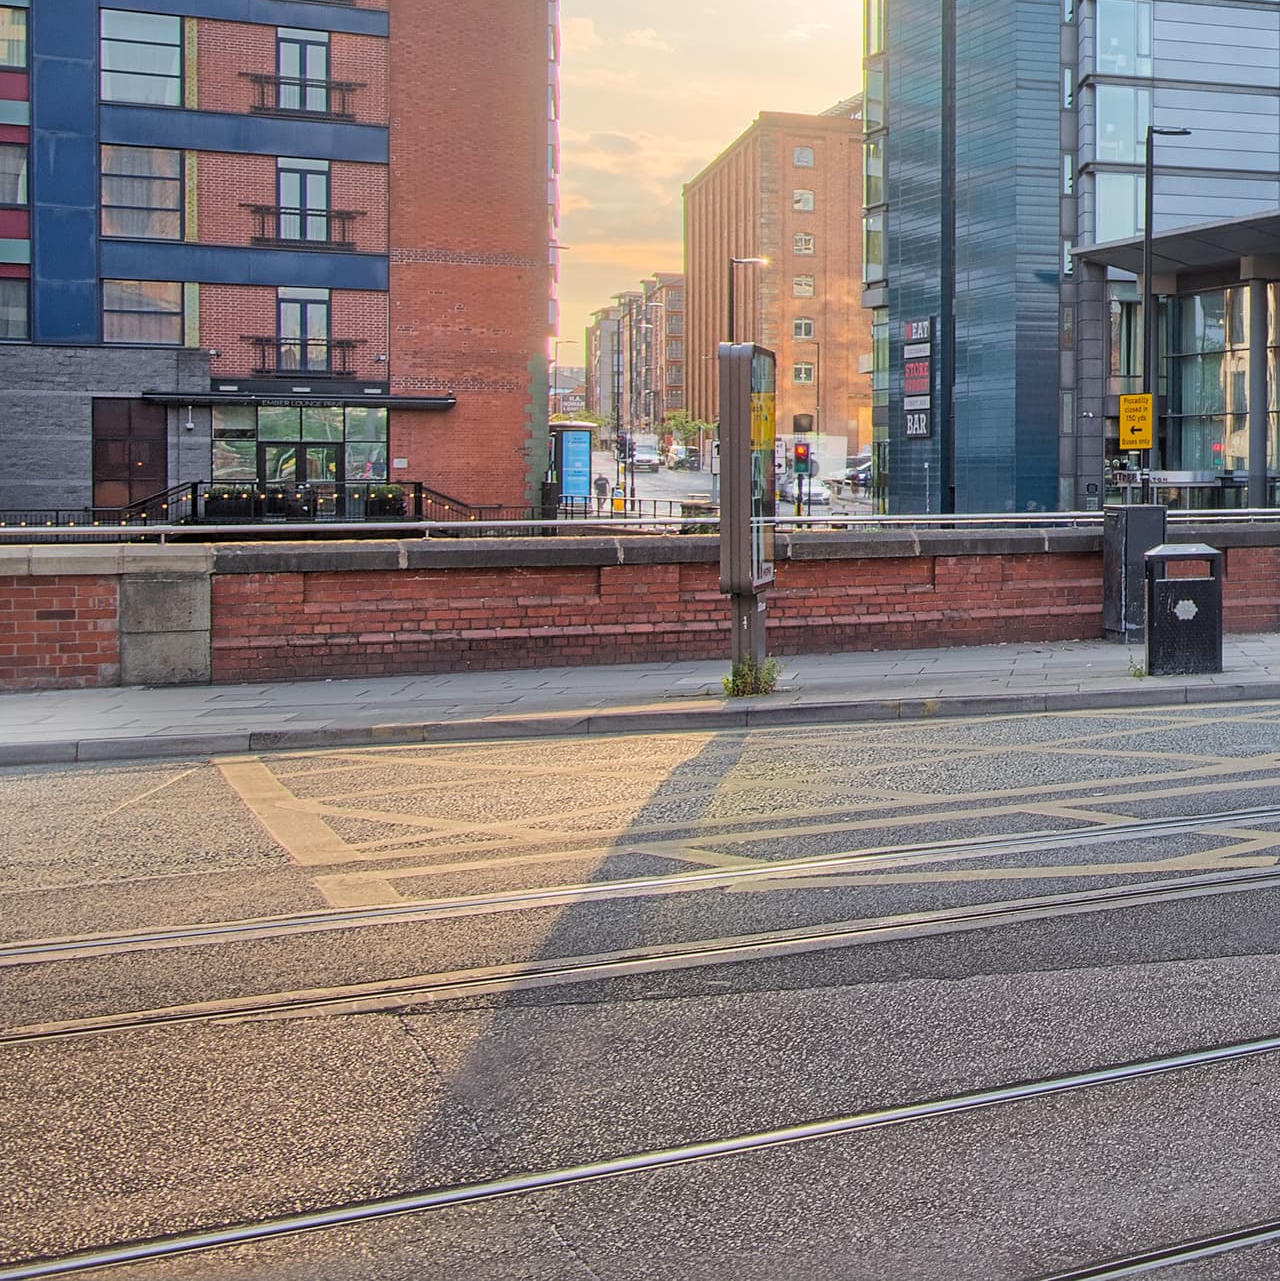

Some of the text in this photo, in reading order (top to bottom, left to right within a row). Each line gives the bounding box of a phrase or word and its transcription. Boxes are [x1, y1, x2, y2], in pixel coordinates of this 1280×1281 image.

[1123, 397, 1149, 405] Piccadilly
[1124, 405, 1142, 413] closed
[906, 413, 927, 434] BAR
[1121, 437, 1150, 447] Buses only
